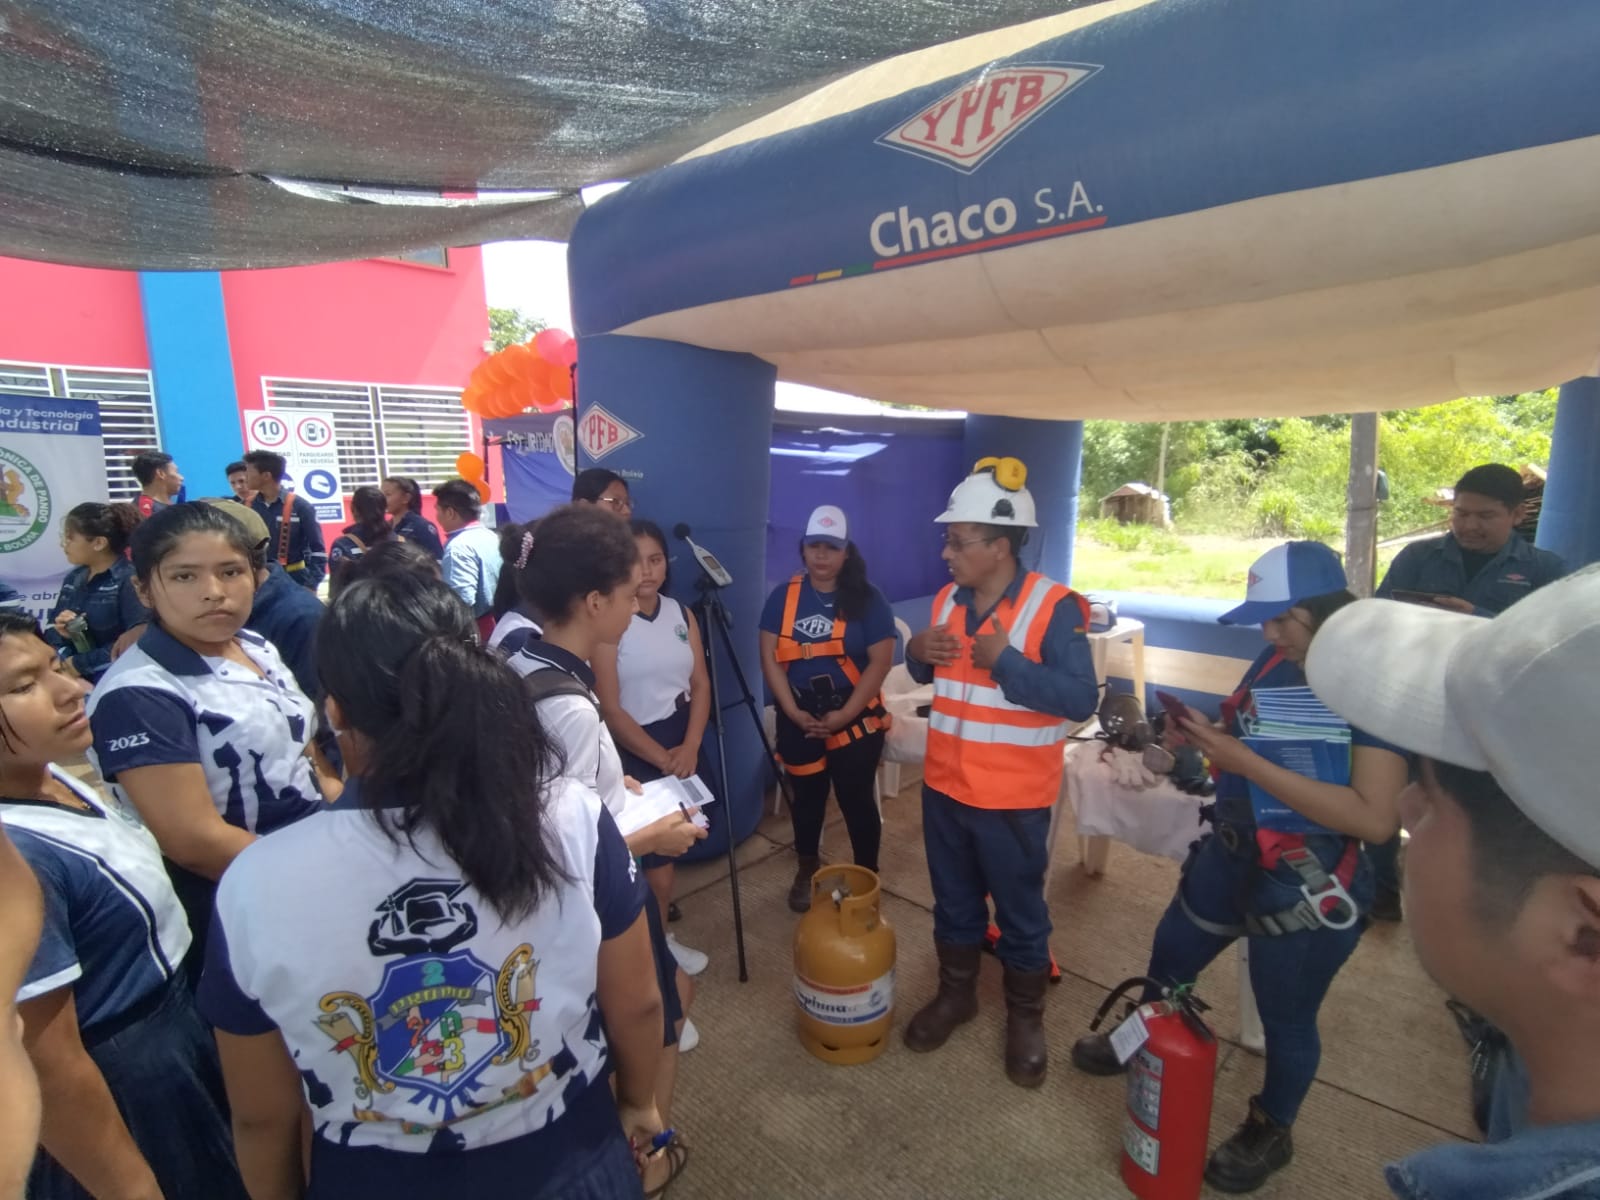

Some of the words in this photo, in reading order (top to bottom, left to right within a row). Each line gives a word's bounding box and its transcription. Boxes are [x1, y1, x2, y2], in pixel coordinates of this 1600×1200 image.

[921, 75, 1045, 147] YPFB
[869, 197, 1018, 257] Chaco
[1034, 180, 1105, 225] S.A.
[12, 409, 24, 418] y
[24, 408, 94, 421] Tecnología
[258, 420, 280, 436] 10
[580, 413, 618, 451] YPFB
[37, 489, 49, 523] PANDO
[802, 619, 832, 634] YPFB
[108, 732, 150, 751] 2023
